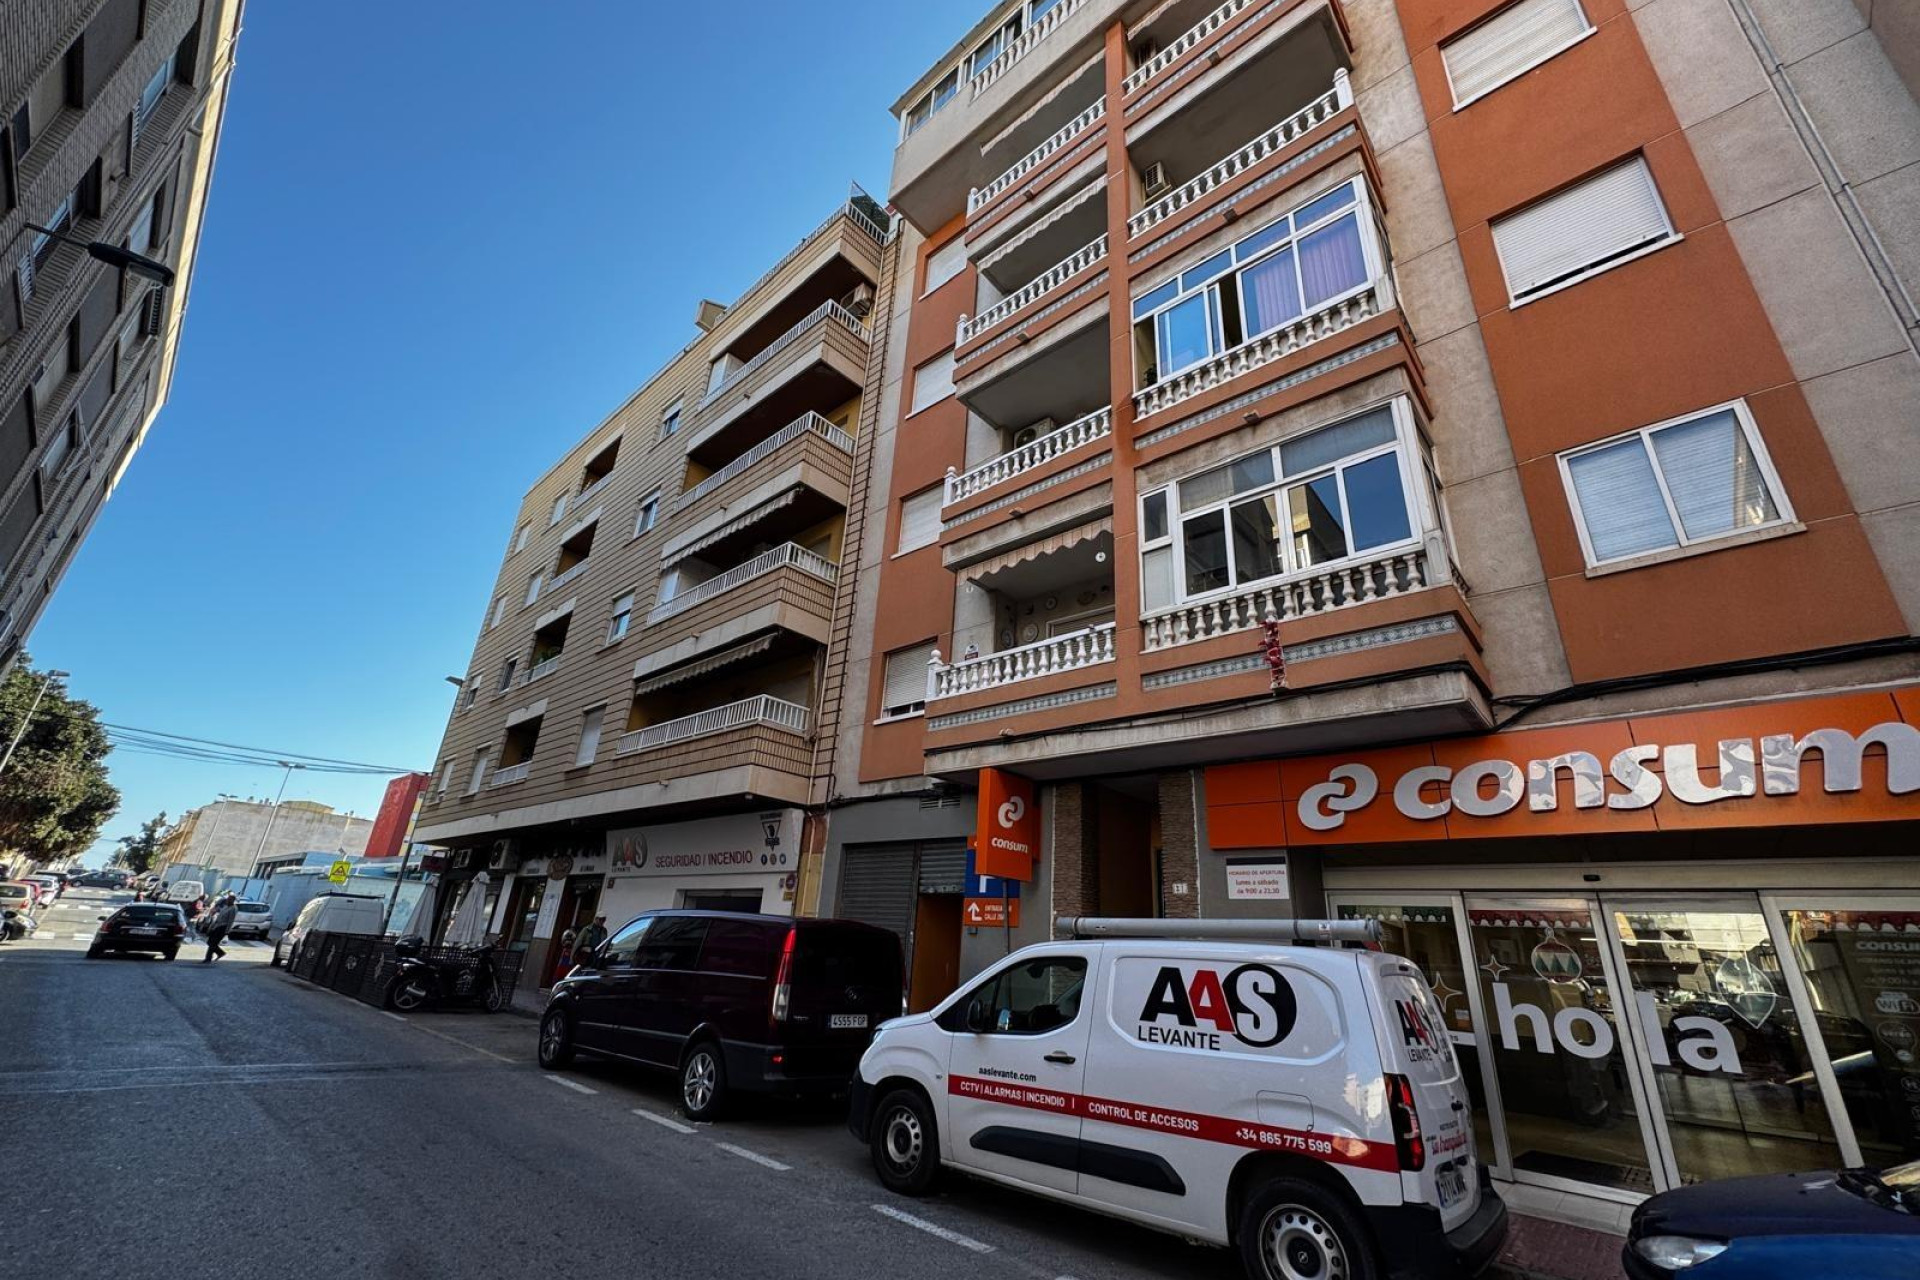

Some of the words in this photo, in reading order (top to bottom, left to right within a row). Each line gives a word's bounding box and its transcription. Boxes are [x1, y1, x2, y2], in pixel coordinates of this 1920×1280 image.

[1393, 722, 1920, 819] consum
[612, 832, 648, 868] AAS
[655, 854, 701, 869] SEGURIDAD
[708, 850, 753, 865] INCENDIO
[991, 837, 1028, 854] consum
[1139, 963, 1297, 1048] AAS
[1138, 1025, 1221, 1050] LEVANTE
[978, 1066, 1037, 1082] aaslevante.com
[960, 1081, 980, 1094] CCTV
[984, 1085, 1022, 1101] ALARMAS
[1026, 1091, 1066, 1108] INCENDIO
[1088, 1102, 1133, 1120] CONTROL
[1134, 1110, 1148, 1122] DE
[1150, 1113, 1200, 1131] ACCESOS
[1235, 1127, 1257, 1141] +34
[1259, 1131, 1282, 1145] 865
[1283, 1134, 1307, 1149] 775
[1307, 1138, 1332, 1154] 599
